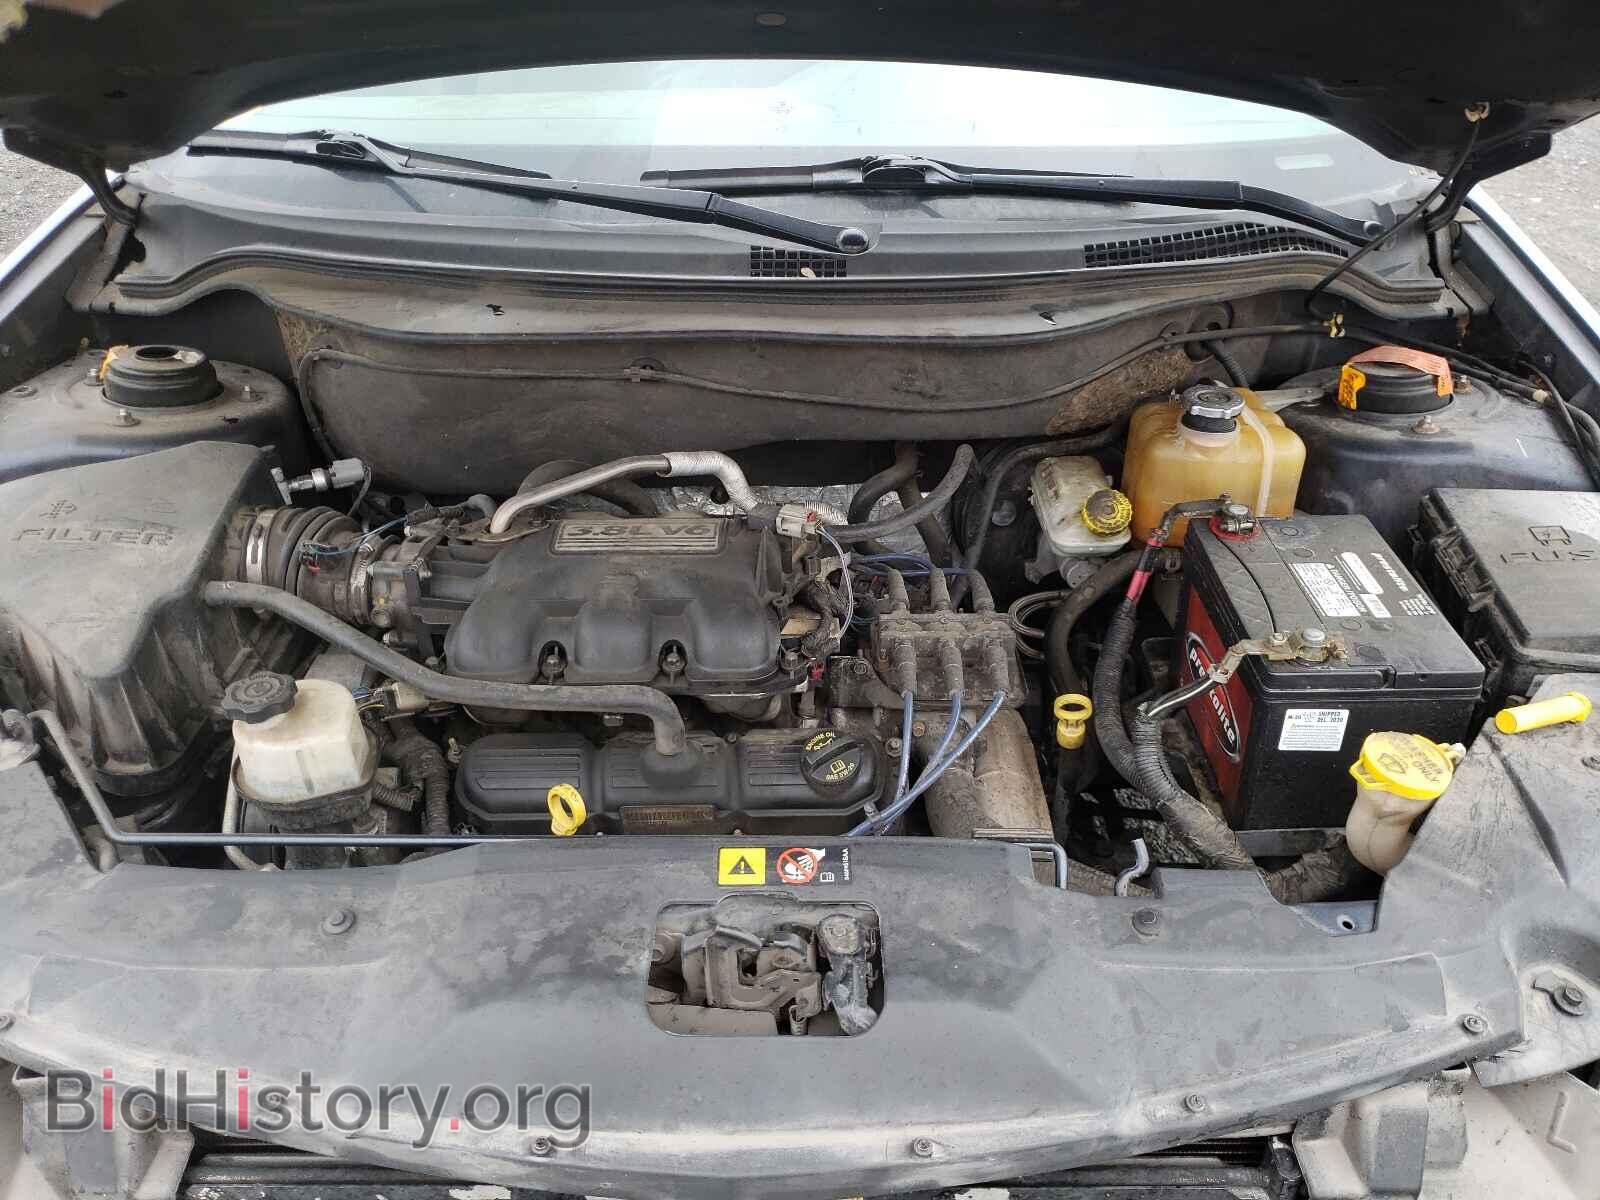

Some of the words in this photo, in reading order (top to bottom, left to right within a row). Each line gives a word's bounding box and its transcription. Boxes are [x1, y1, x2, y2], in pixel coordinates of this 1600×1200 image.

[11, 526, 174, 546] FILTER
[567, 524, 652, 537] 3.8L
[660, 524, 711, 536] V6
[1500, 549, 1600, 563] FUS
[1189, 646, 1236, 745] pretolite
[805, 733, 826, 751] ENGINE
[825, 730, 837, 738] OIL
